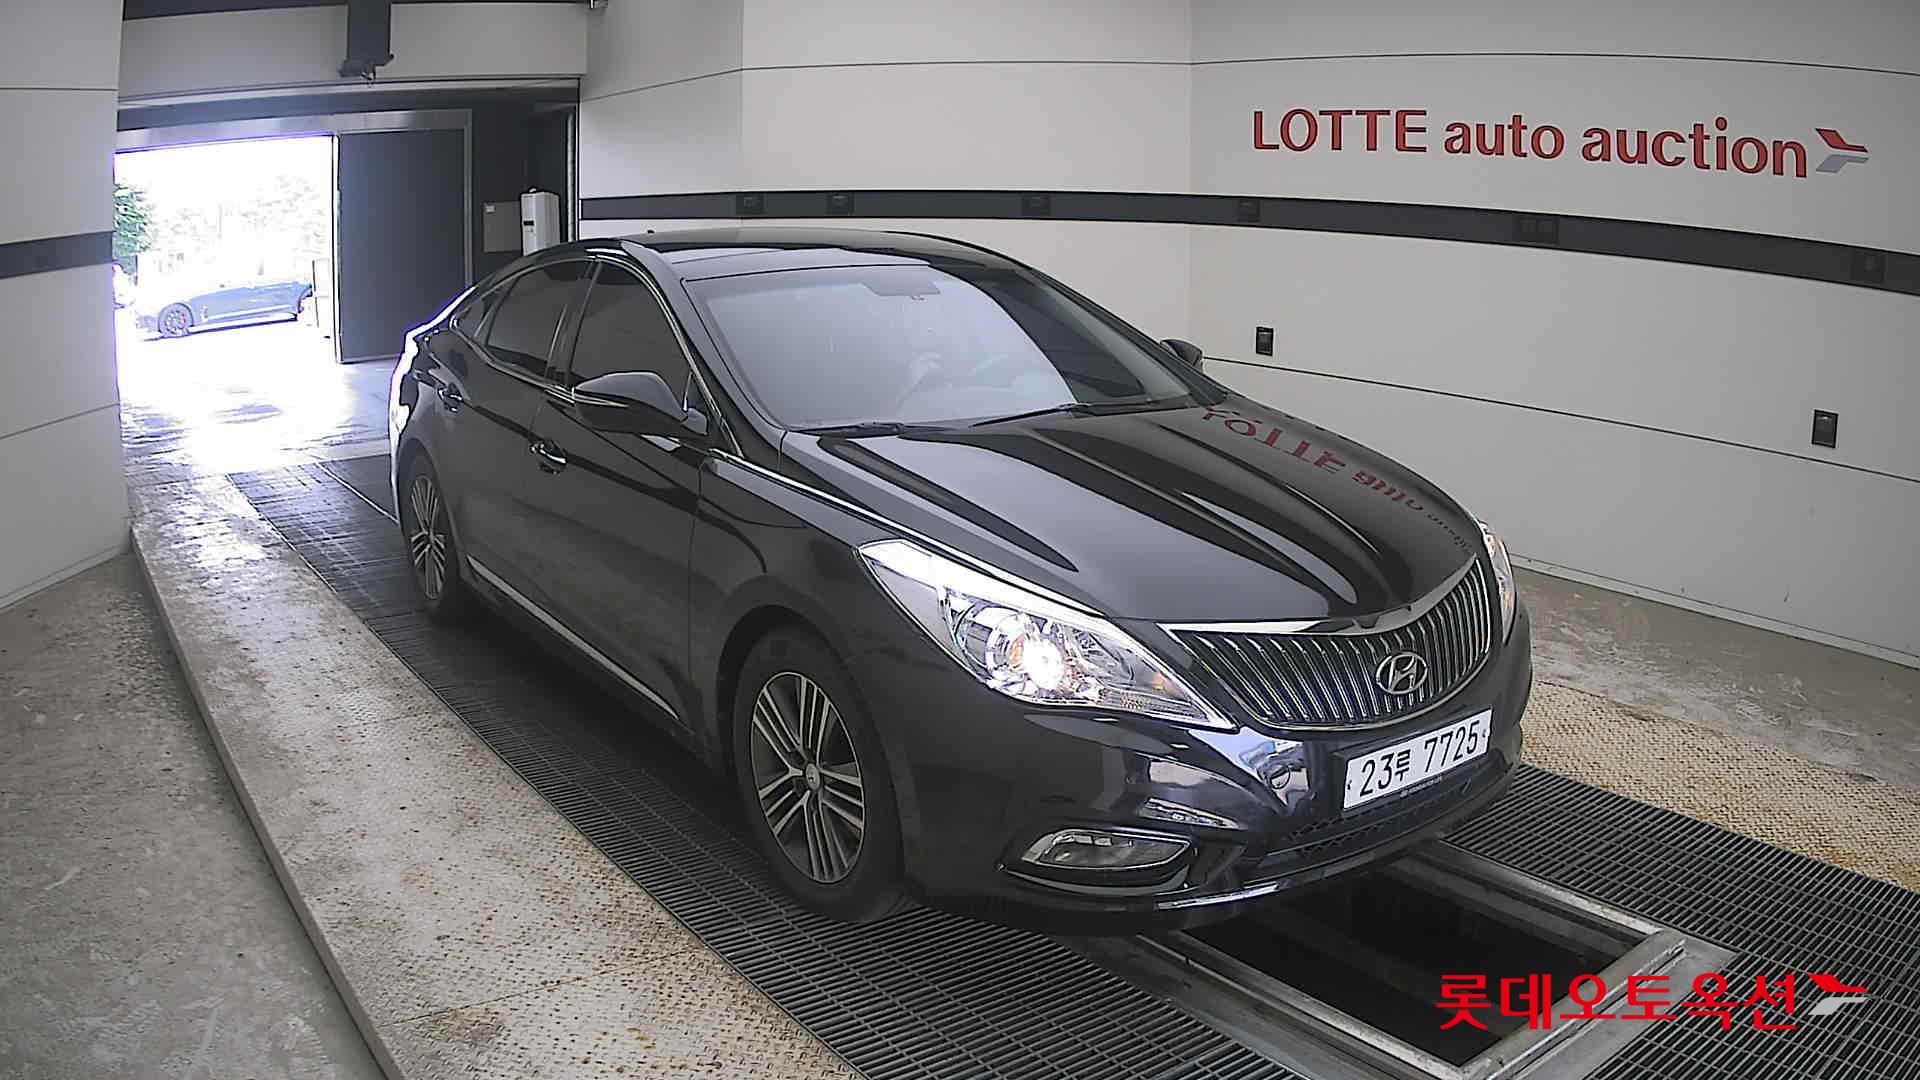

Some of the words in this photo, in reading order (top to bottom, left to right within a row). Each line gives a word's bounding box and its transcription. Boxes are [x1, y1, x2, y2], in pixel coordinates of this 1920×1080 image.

[1253, 110, 1428, 153] LOTTE
[1444, 115, 1566, 159] auto
[1582, 117, 1808, 178] auction
[1359, 749, 1412, 798] 23루
[1423, 719, 1481, 773] 7725
